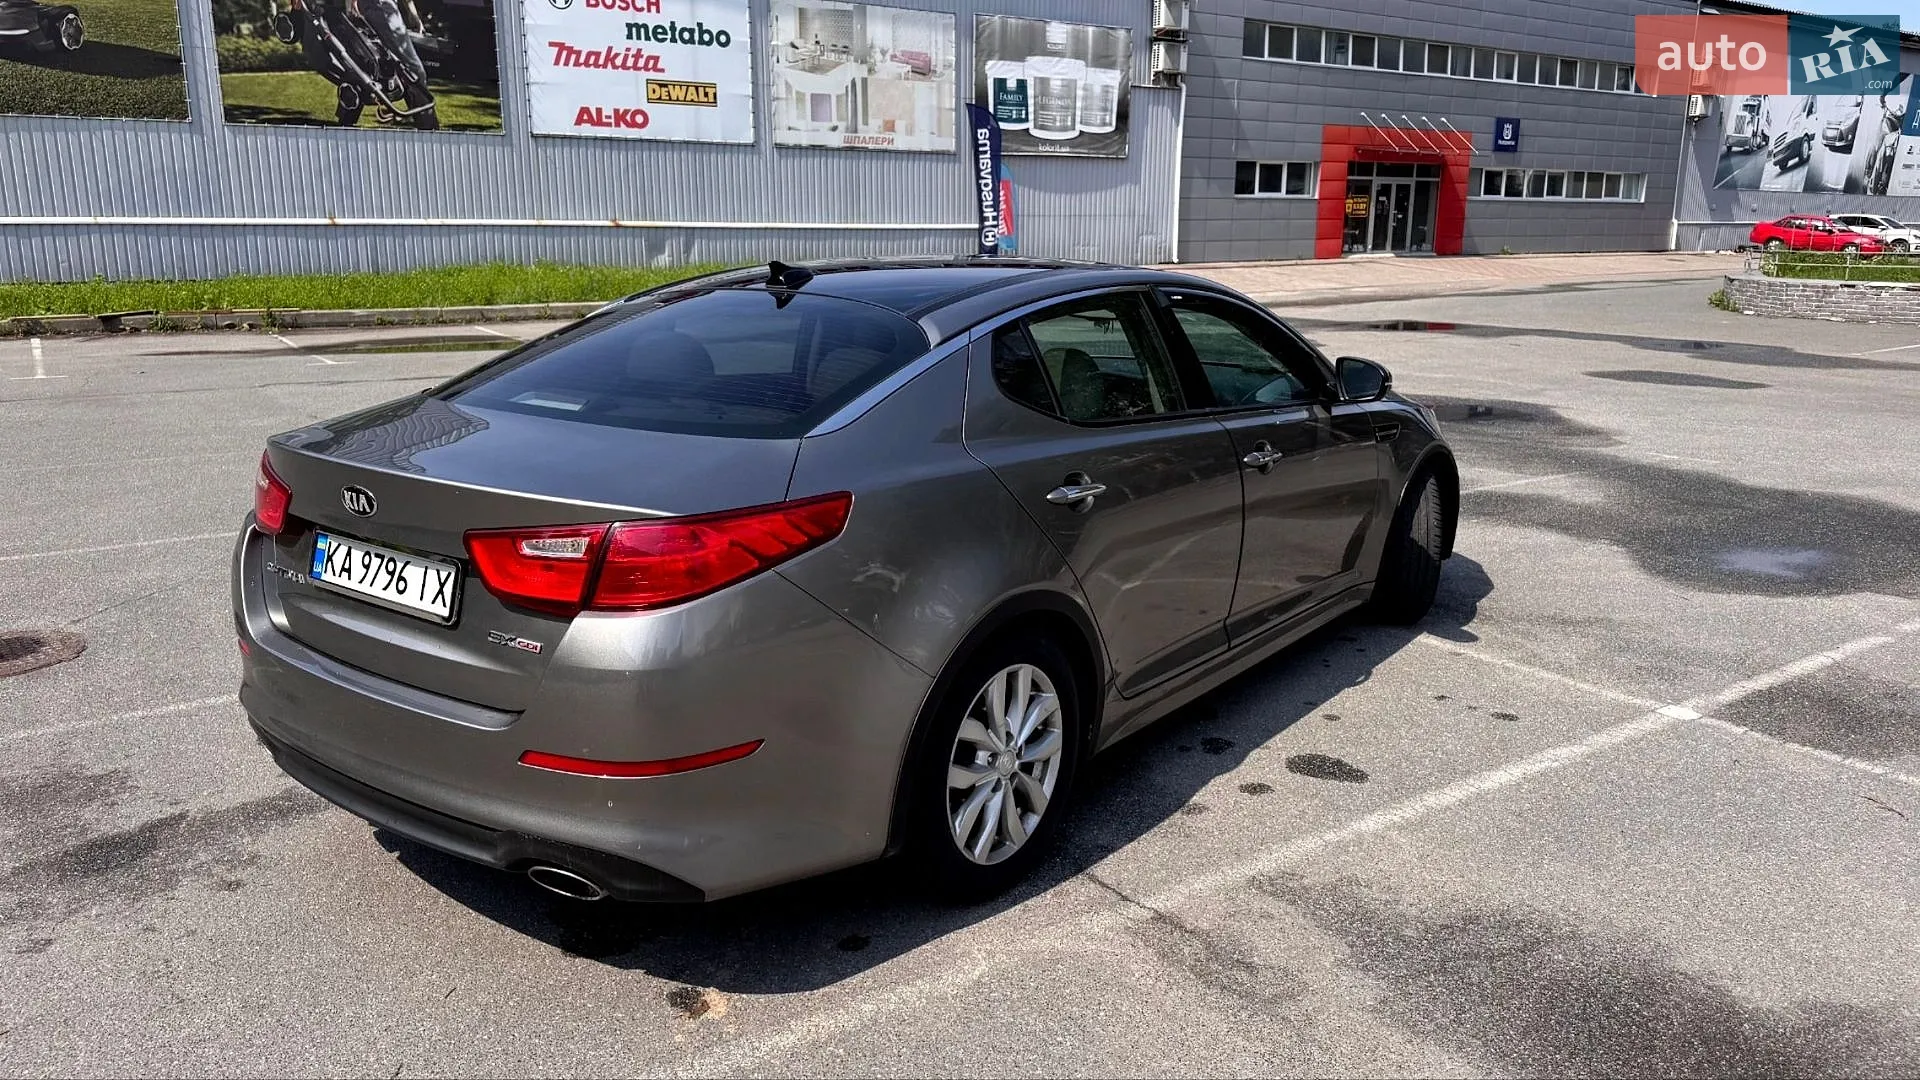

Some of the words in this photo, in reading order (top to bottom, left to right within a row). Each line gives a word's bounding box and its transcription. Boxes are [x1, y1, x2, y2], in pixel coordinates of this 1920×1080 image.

[625, 21, 731, 49] metabo
[547, 41, 666, 74] Makita
[574, 106, 651, 130] AL-KO
[843, 135, 895, 146] ШПАЛЕРИ
[343, 489, 370, 514] KIA
[323, 540, 352, 581] KA
[358, 550, 411, 595] 9796
[419, 565, 452, 608] IX
